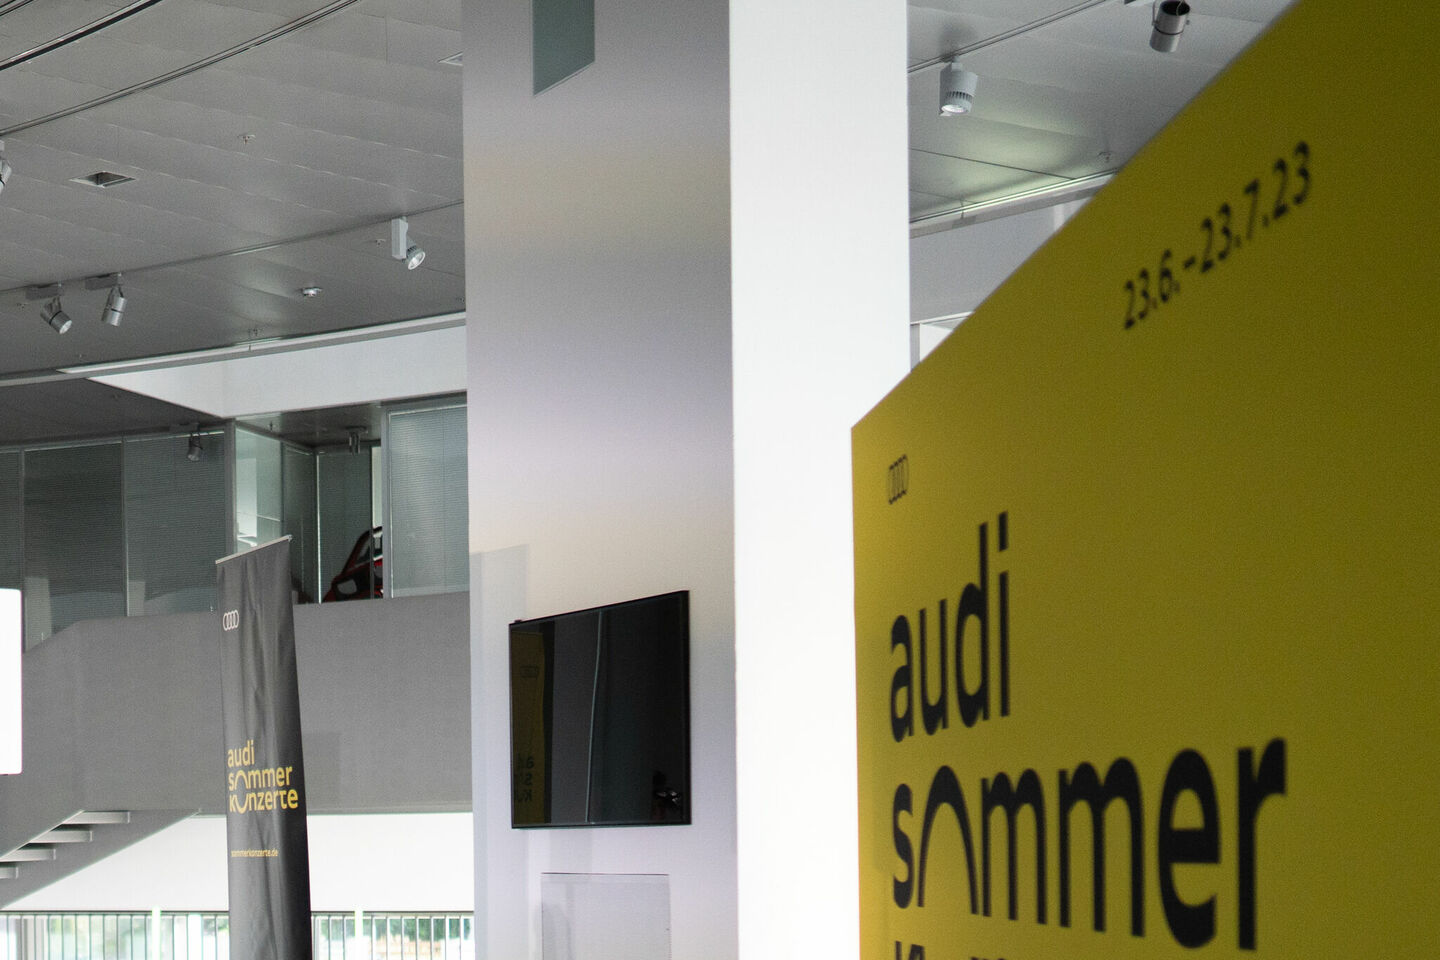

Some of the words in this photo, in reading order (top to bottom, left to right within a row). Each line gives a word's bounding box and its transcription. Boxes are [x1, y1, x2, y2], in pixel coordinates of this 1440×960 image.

[889, 509, 1010, 744] audi
[227, 739, 256, 768] audi
[228, 765, 294, 792] sommer
[229, 788, 299, 815] konzerte
[892, 736, 1288, 953] sommer
